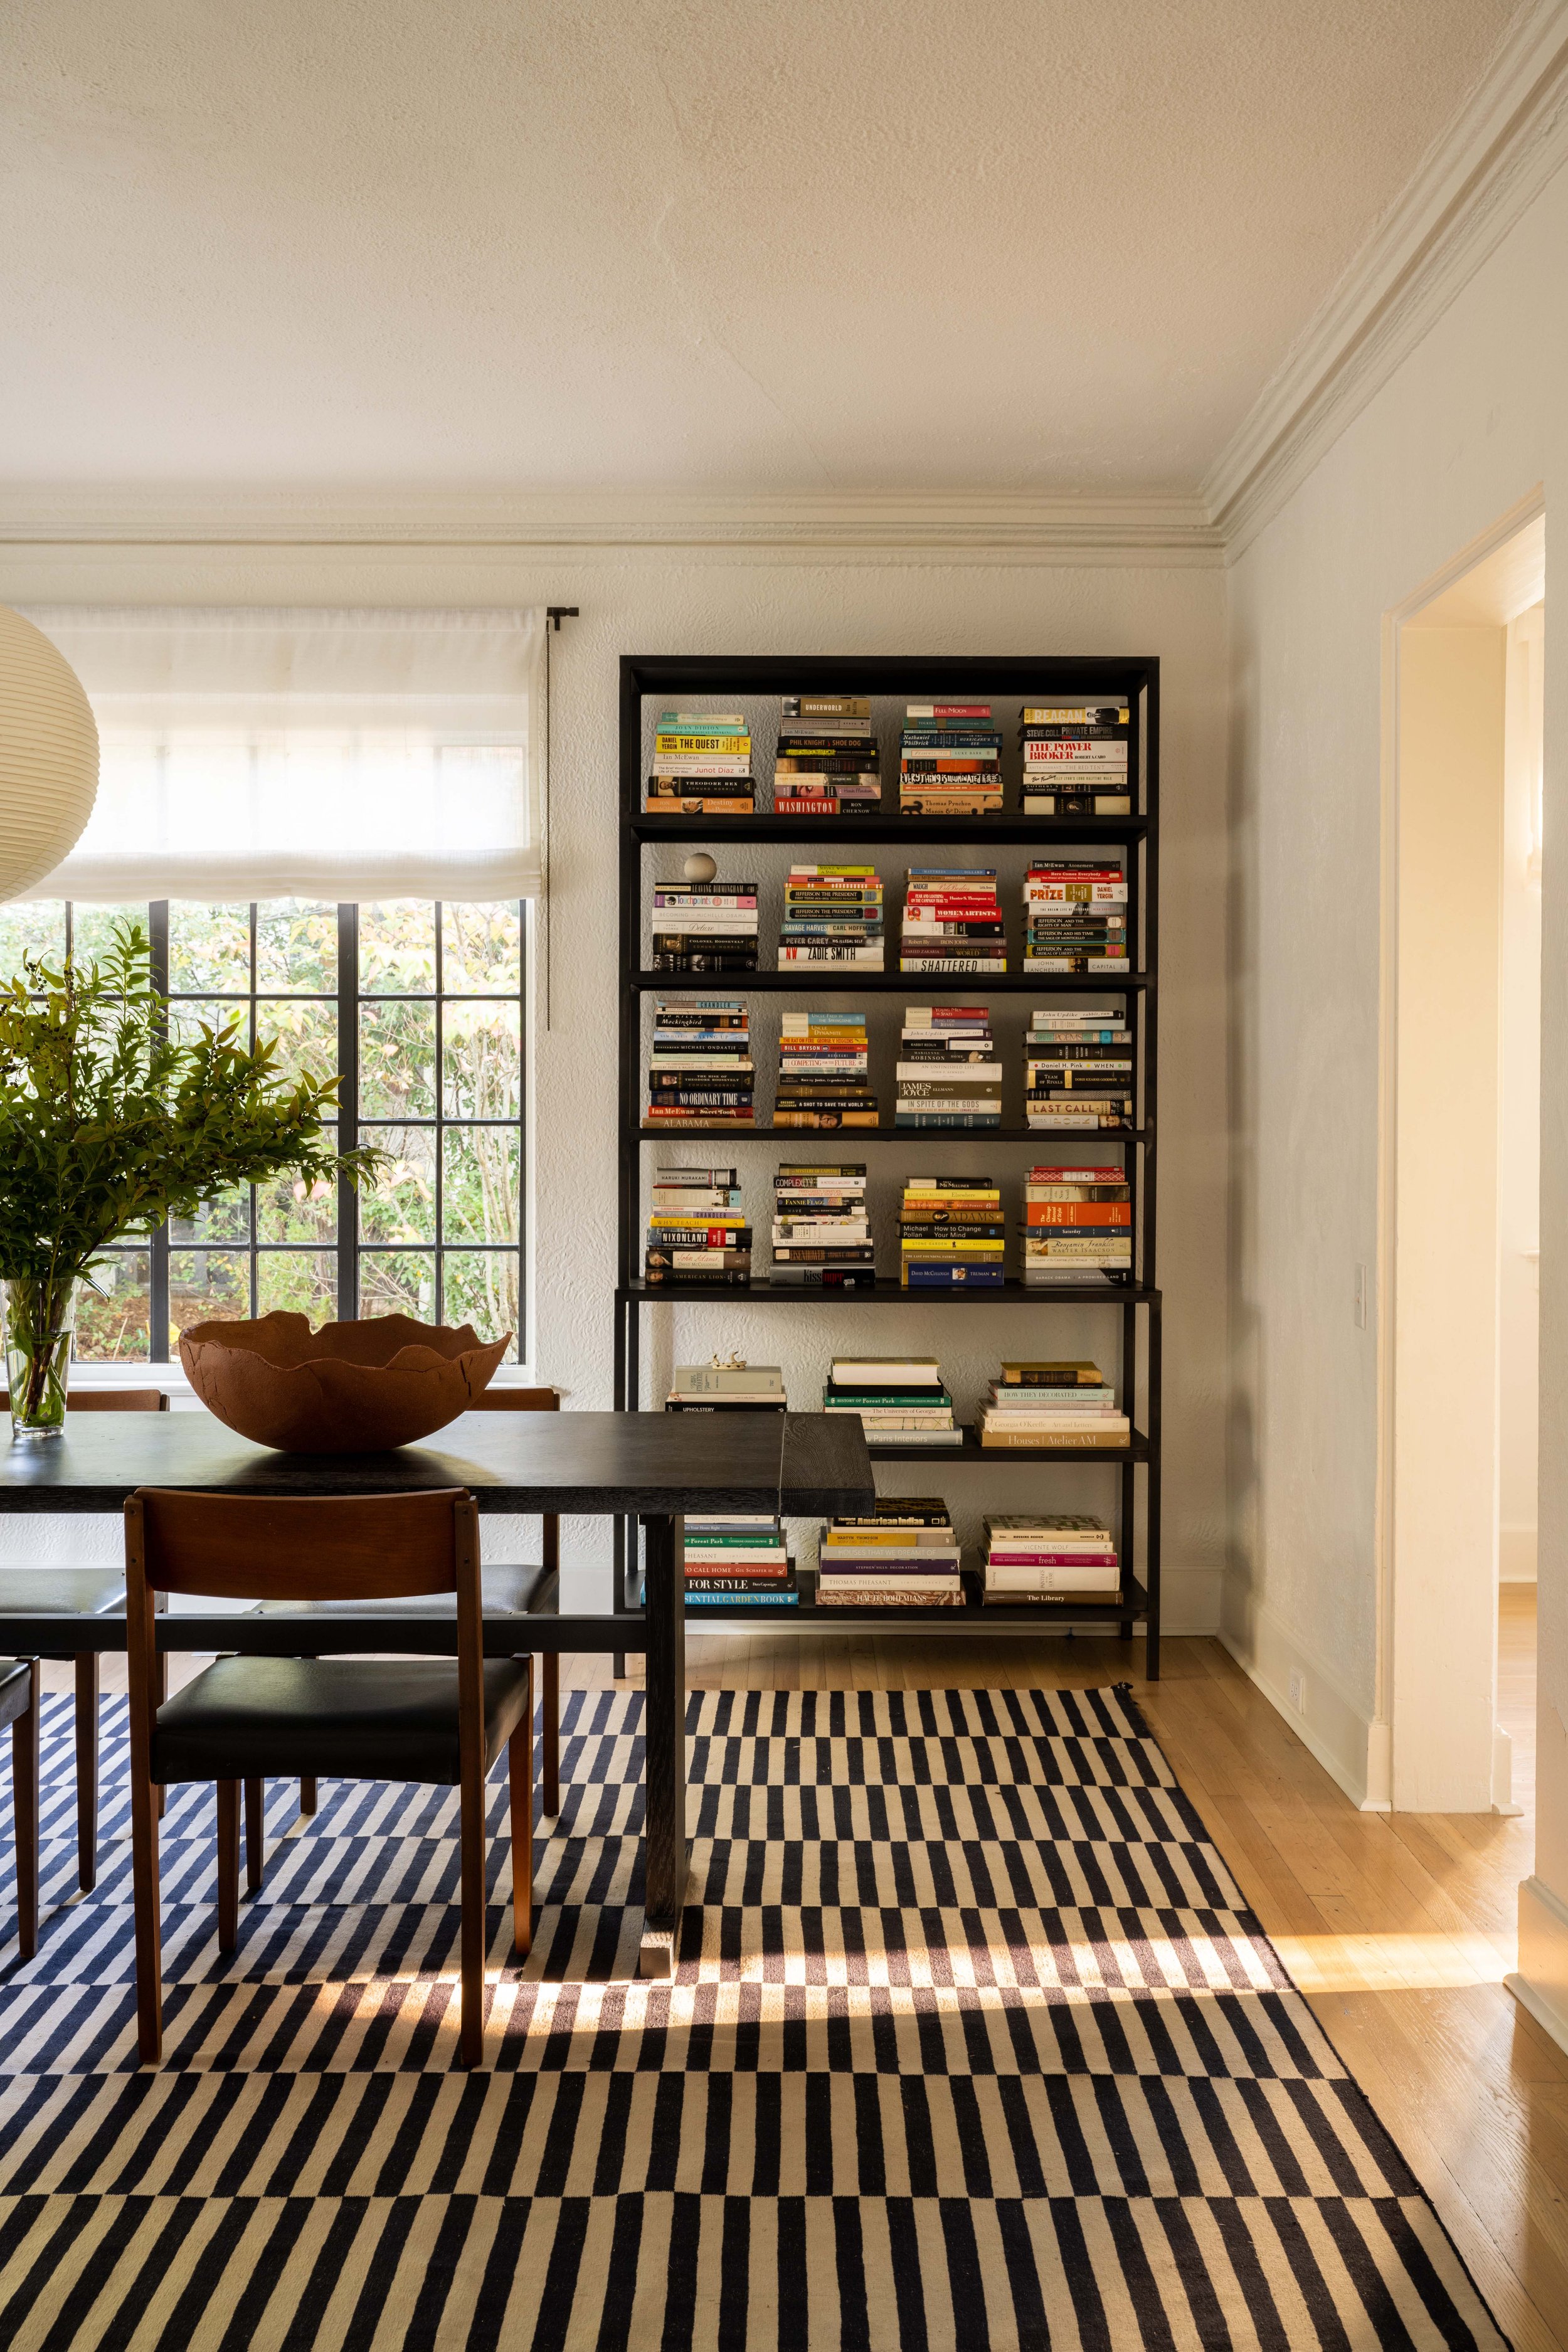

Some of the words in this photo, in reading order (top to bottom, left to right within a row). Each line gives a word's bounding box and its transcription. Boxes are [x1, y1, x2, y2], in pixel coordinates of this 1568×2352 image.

[1035, 710, 1083, 723] REAGAN
[680, 739, 694, 748] THE
[696, 739, 719, 749] QUEST
[779, 802, 832, 812] WASHINGTON
[1030, 890, 1062, 899] PRIZE
[677, 896, 711, 906] Touchpoints
[787, 948, 797, 960] NW
[808, 948, 828, 960] ZADIE
[832, 948, 856, 960] SMITH
[921, 960, 977, 972] SHATTERED
[680, 1093, 688, 1104] NO
[690, 1093, 720, 1104] ORDINARY
[723, 1093, 737, 1104] TIME
[663, 1233, 706, 1242] NIXONLAND
[1009, 1436, 1039, 1444] Houses
[1048, 1436, 1077, 1444] Atelier
[1078, 1436, 1096, 1444] AM
[857, 1517, 897, 1525] American
[898, 1517, 924, 1525] Indian
[689, 1580, 711, 1589] FOR
[714, 1581, 748, 1589] STYLE
